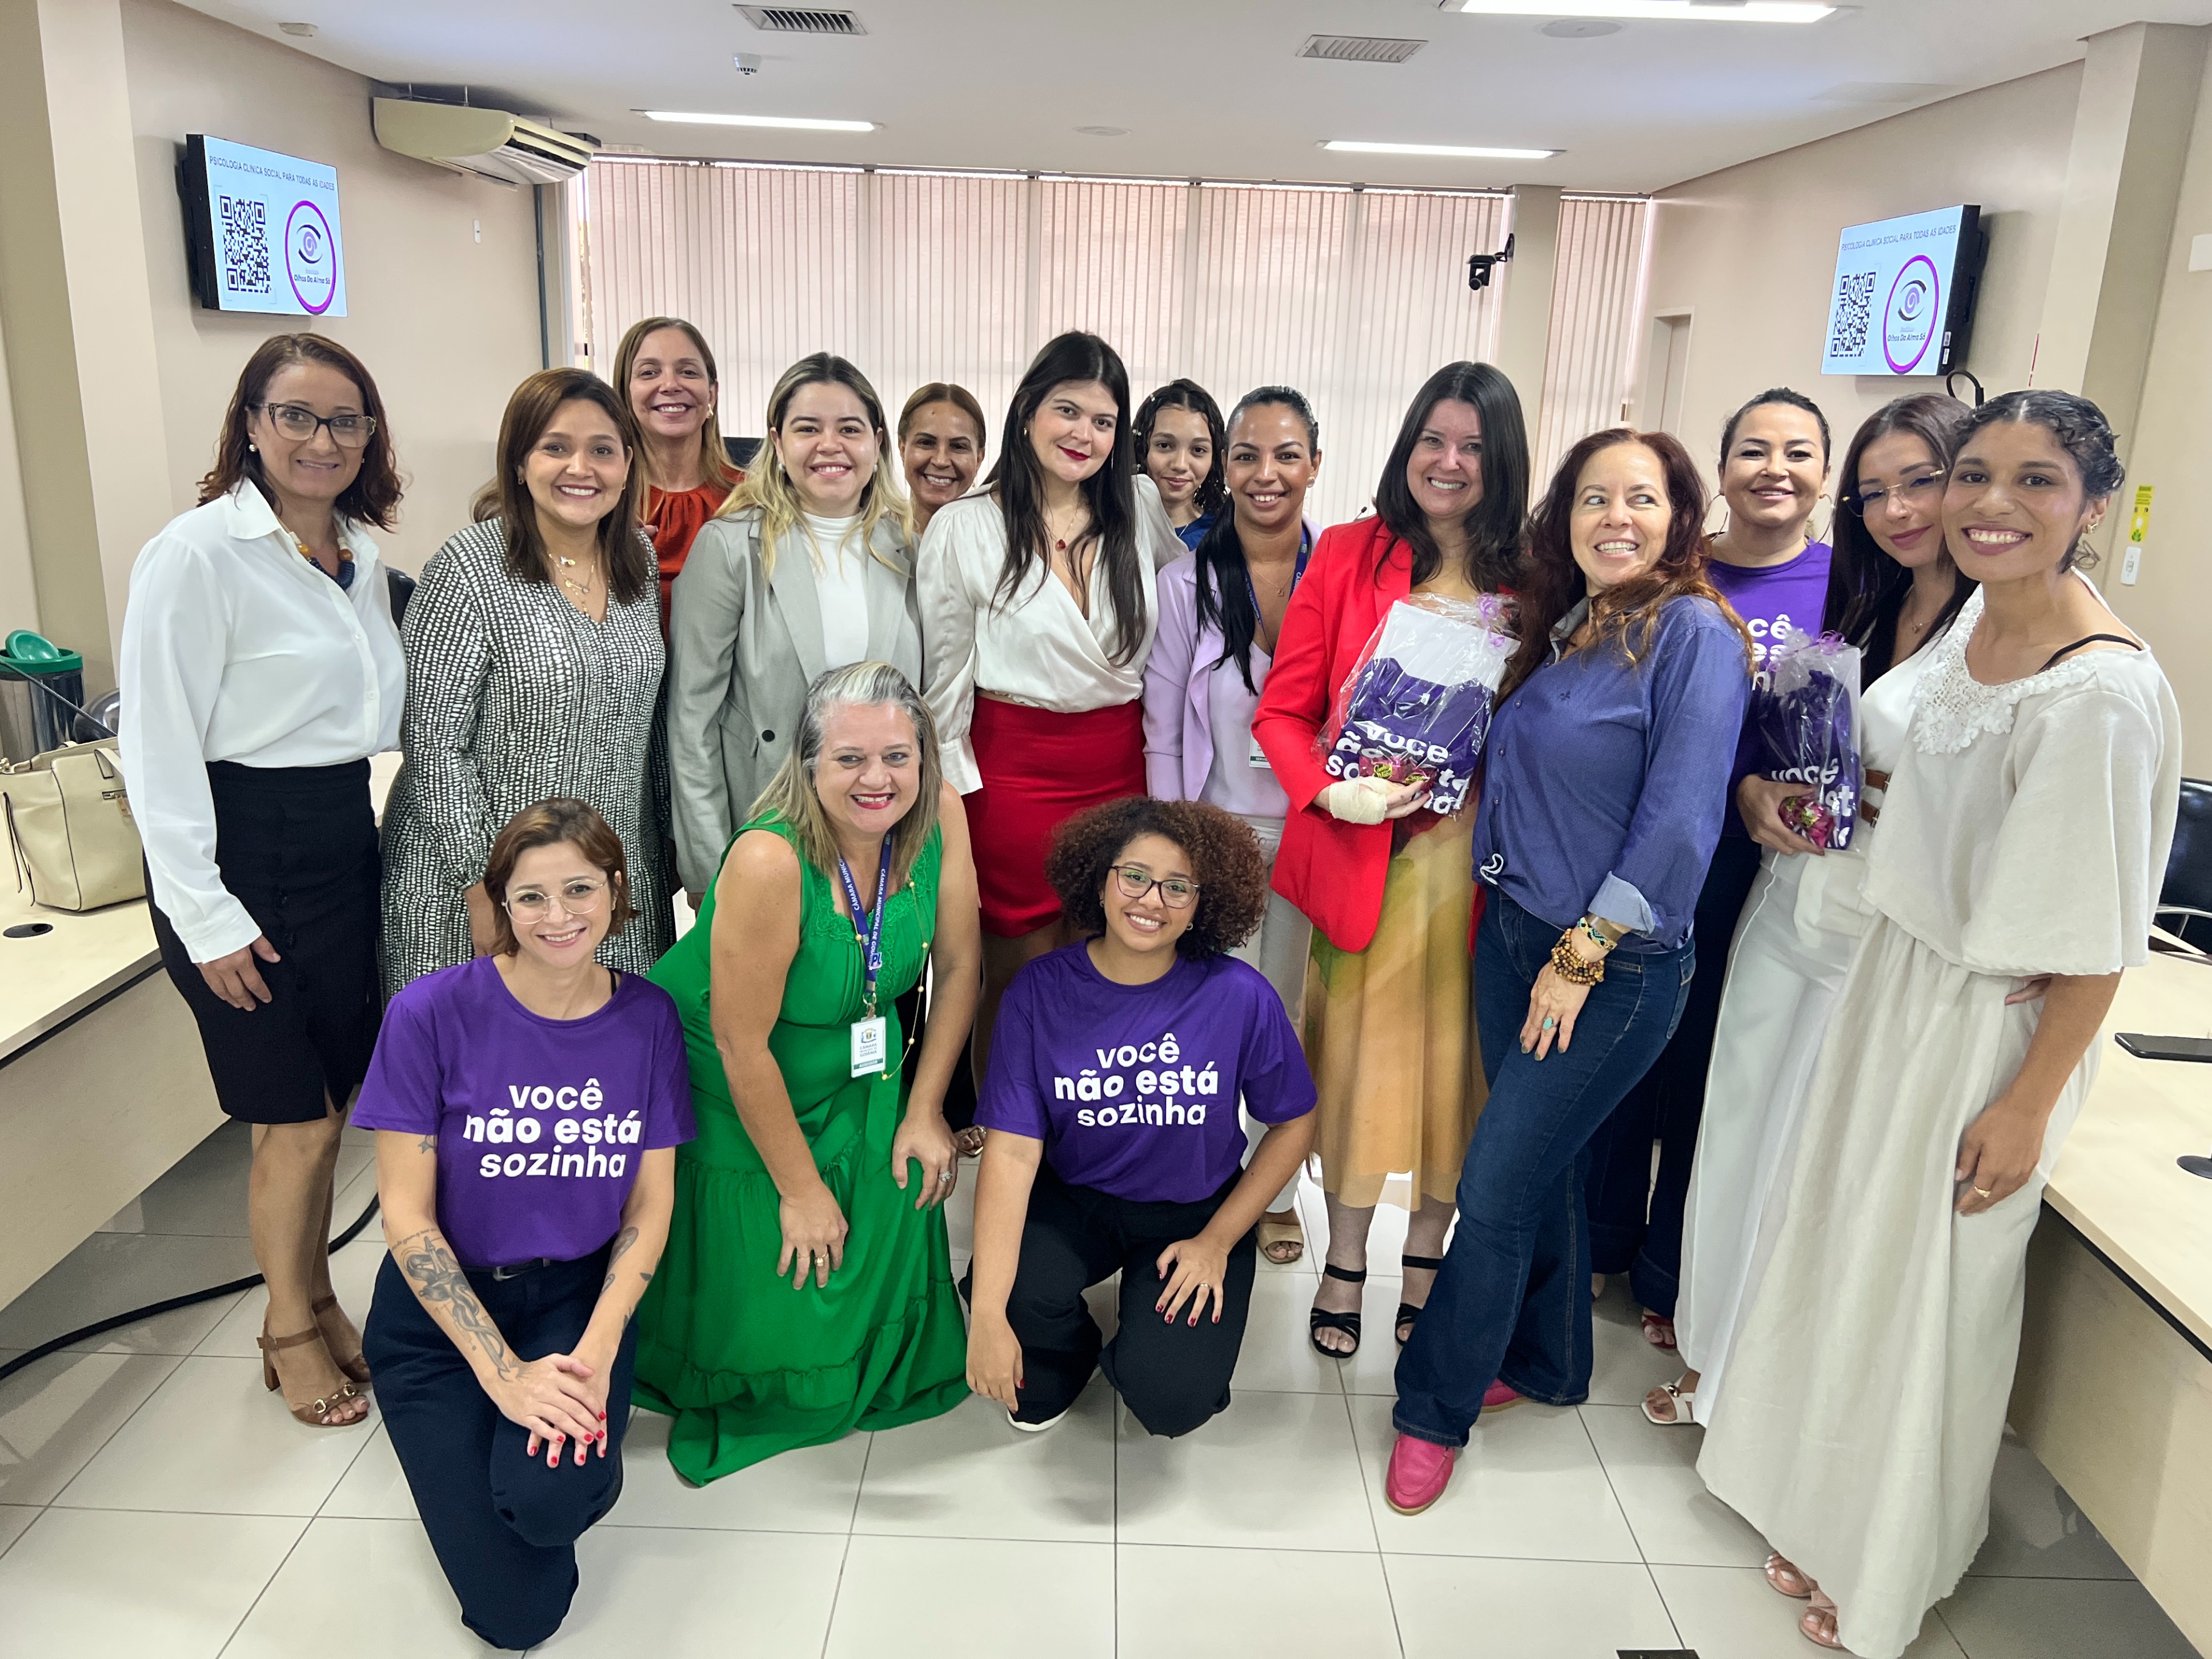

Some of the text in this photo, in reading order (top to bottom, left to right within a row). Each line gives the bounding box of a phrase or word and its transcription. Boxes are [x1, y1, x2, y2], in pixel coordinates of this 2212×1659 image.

[209, 155, 242, 170] PSICOLOGIA
[263, 167, 282, 179] SOCIAL
[282, 172, 295, 182] PARA
[295, 175, 311, 186] TODAS
[312, 179, 319, 187] AS
[319, 180, 335, 191] IDADES
[1841, 241, 1865, 251] PSICOLOGIA
[1883, 235, 1899, 245] SOCIAL
[1900, 233, 1912, 242] PARA
[1913, 229, 1929, 239] TODAS
[1930, 227, 1937, 237] AS
[1937, 225, 1957, 235] IDADES
[1747, 614, 1792, 639] cê
[873, 896, 882, 930] MUNICIPAL
[872, 931, 878, 940] DE
[1096, 1033, 1180, 1069] você
[508, 1078, 603, 1111] você
[1054, 1061, 1219, 1101] não está
[463, 1107, 642, 1144] não está
[1077, 1095, 1207, 1127] sozinha
[479, 1144, 626, 1178] sozinha
